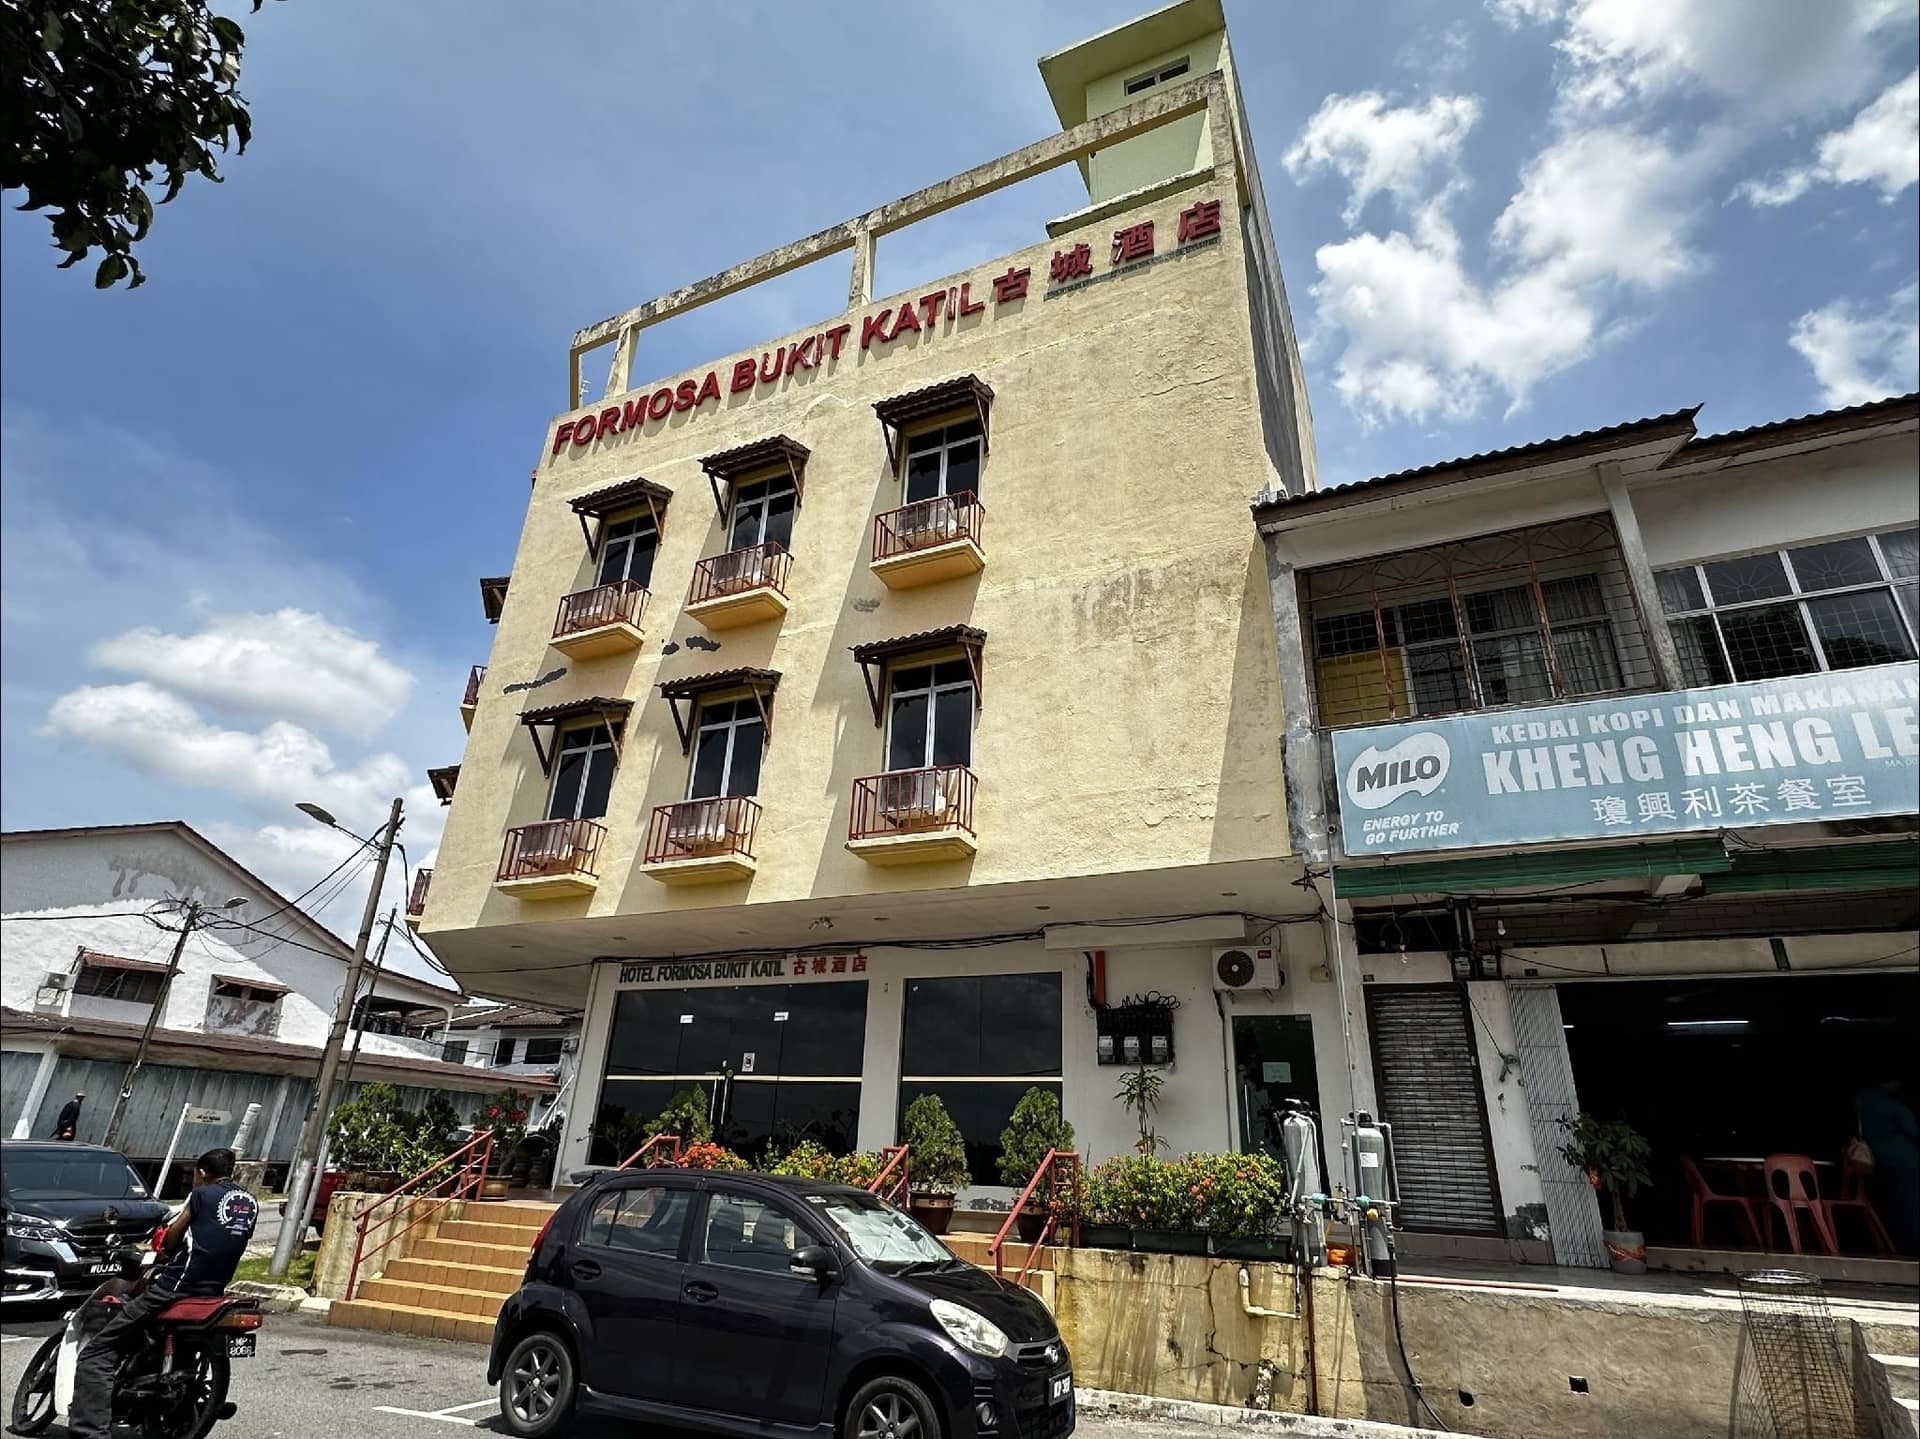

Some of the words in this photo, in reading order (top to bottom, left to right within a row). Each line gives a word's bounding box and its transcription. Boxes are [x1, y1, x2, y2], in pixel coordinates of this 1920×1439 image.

[992, 199, 1221, 304] 古城酒店
[552, 371, 722, 455] FORMOSA
[730, 323, 850, 393] BUKIT
[861, 282, 985, 349] KATIL
[1492, 717, 1579, 744] KEDAI
[1588, 708, 1665, 735] KOPI
[1672, 698, 1742, 725] DAN
[1357, 755, 1441, 793] MILO
[1482, 735, 1665, 795] KHENG
[1675, 716, 1841, 777] HENG
[1591, 773, 1872, 826] 瓊興利茶餐室
[1362, 812, 1421, 832] ENERGY
[1424, 810, 1444, 824] TO
[1365, 832, 1386, 845] GO
[1389, 821, 1460, 842] FURTHER
[619, 966, 655, 983] HOTEL
[656, 963, 712, 982] FORMOSA
[714, 961, 749, 979] BUKIT
[750, 959, 785, 977] KATIL
[792, 954, 867, 975] 古城酒店
